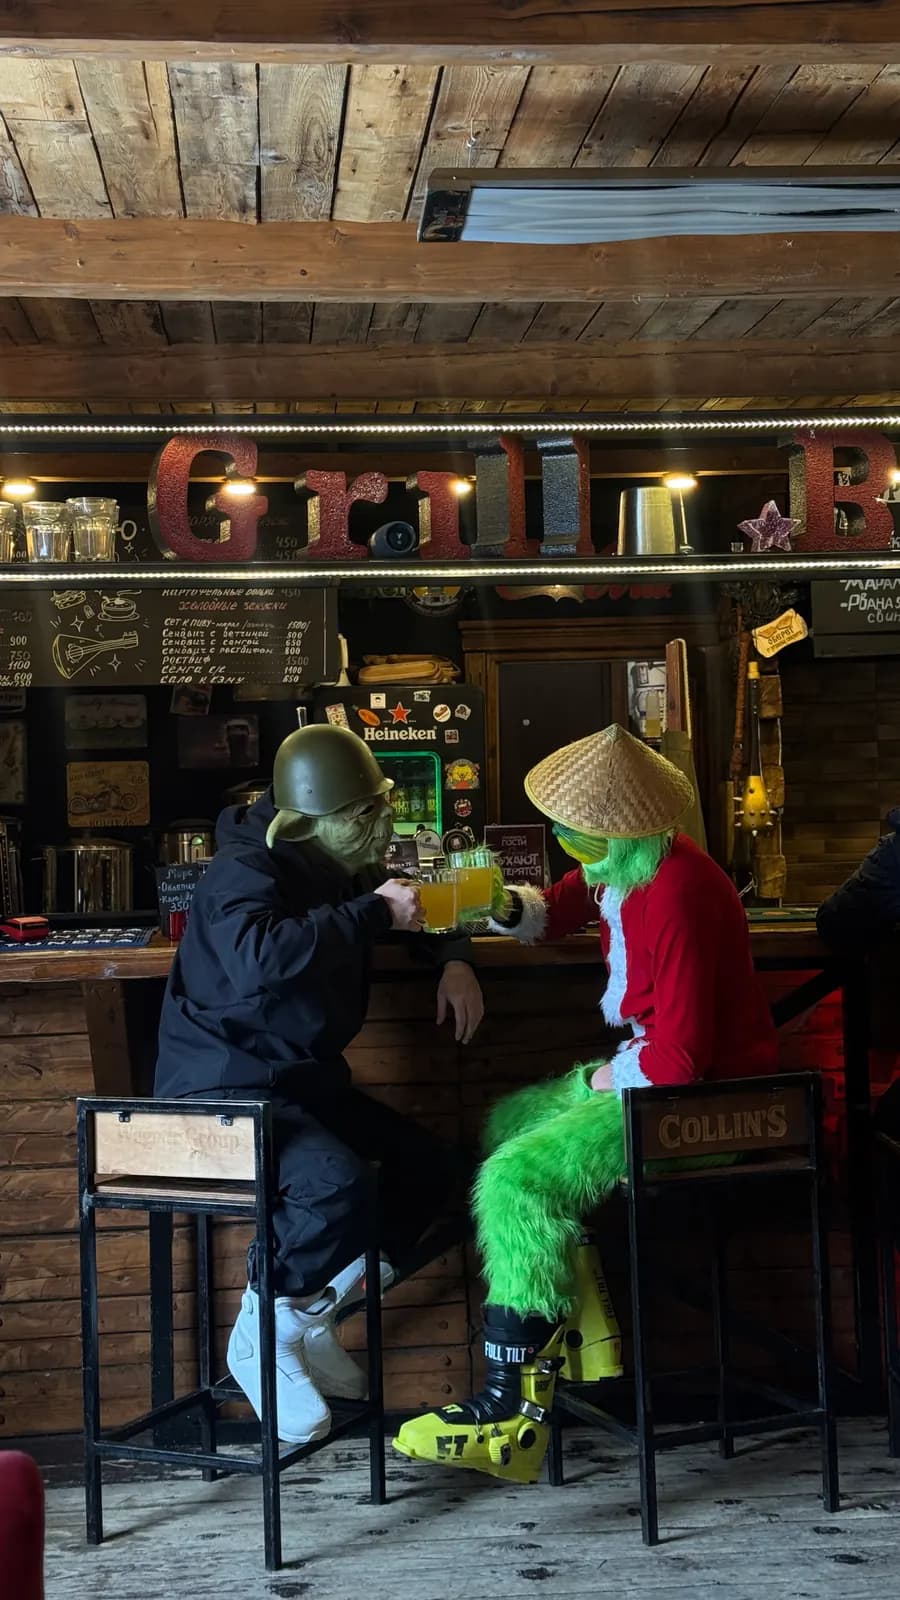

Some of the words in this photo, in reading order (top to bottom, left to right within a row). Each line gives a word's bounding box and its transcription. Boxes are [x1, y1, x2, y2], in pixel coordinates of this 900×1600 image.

[148, 434, 594, 561] Grill
[363, 726, 437, 741] Heineken
[503, 865, 542, 878] ТЕРЯТСЯ
[168, 901, 189, 912] 350
[184, 1126, 240, 1155] Group
[484, 1341, 503, 1362] FULL
[505, 1345, 527, 1363] TILT
